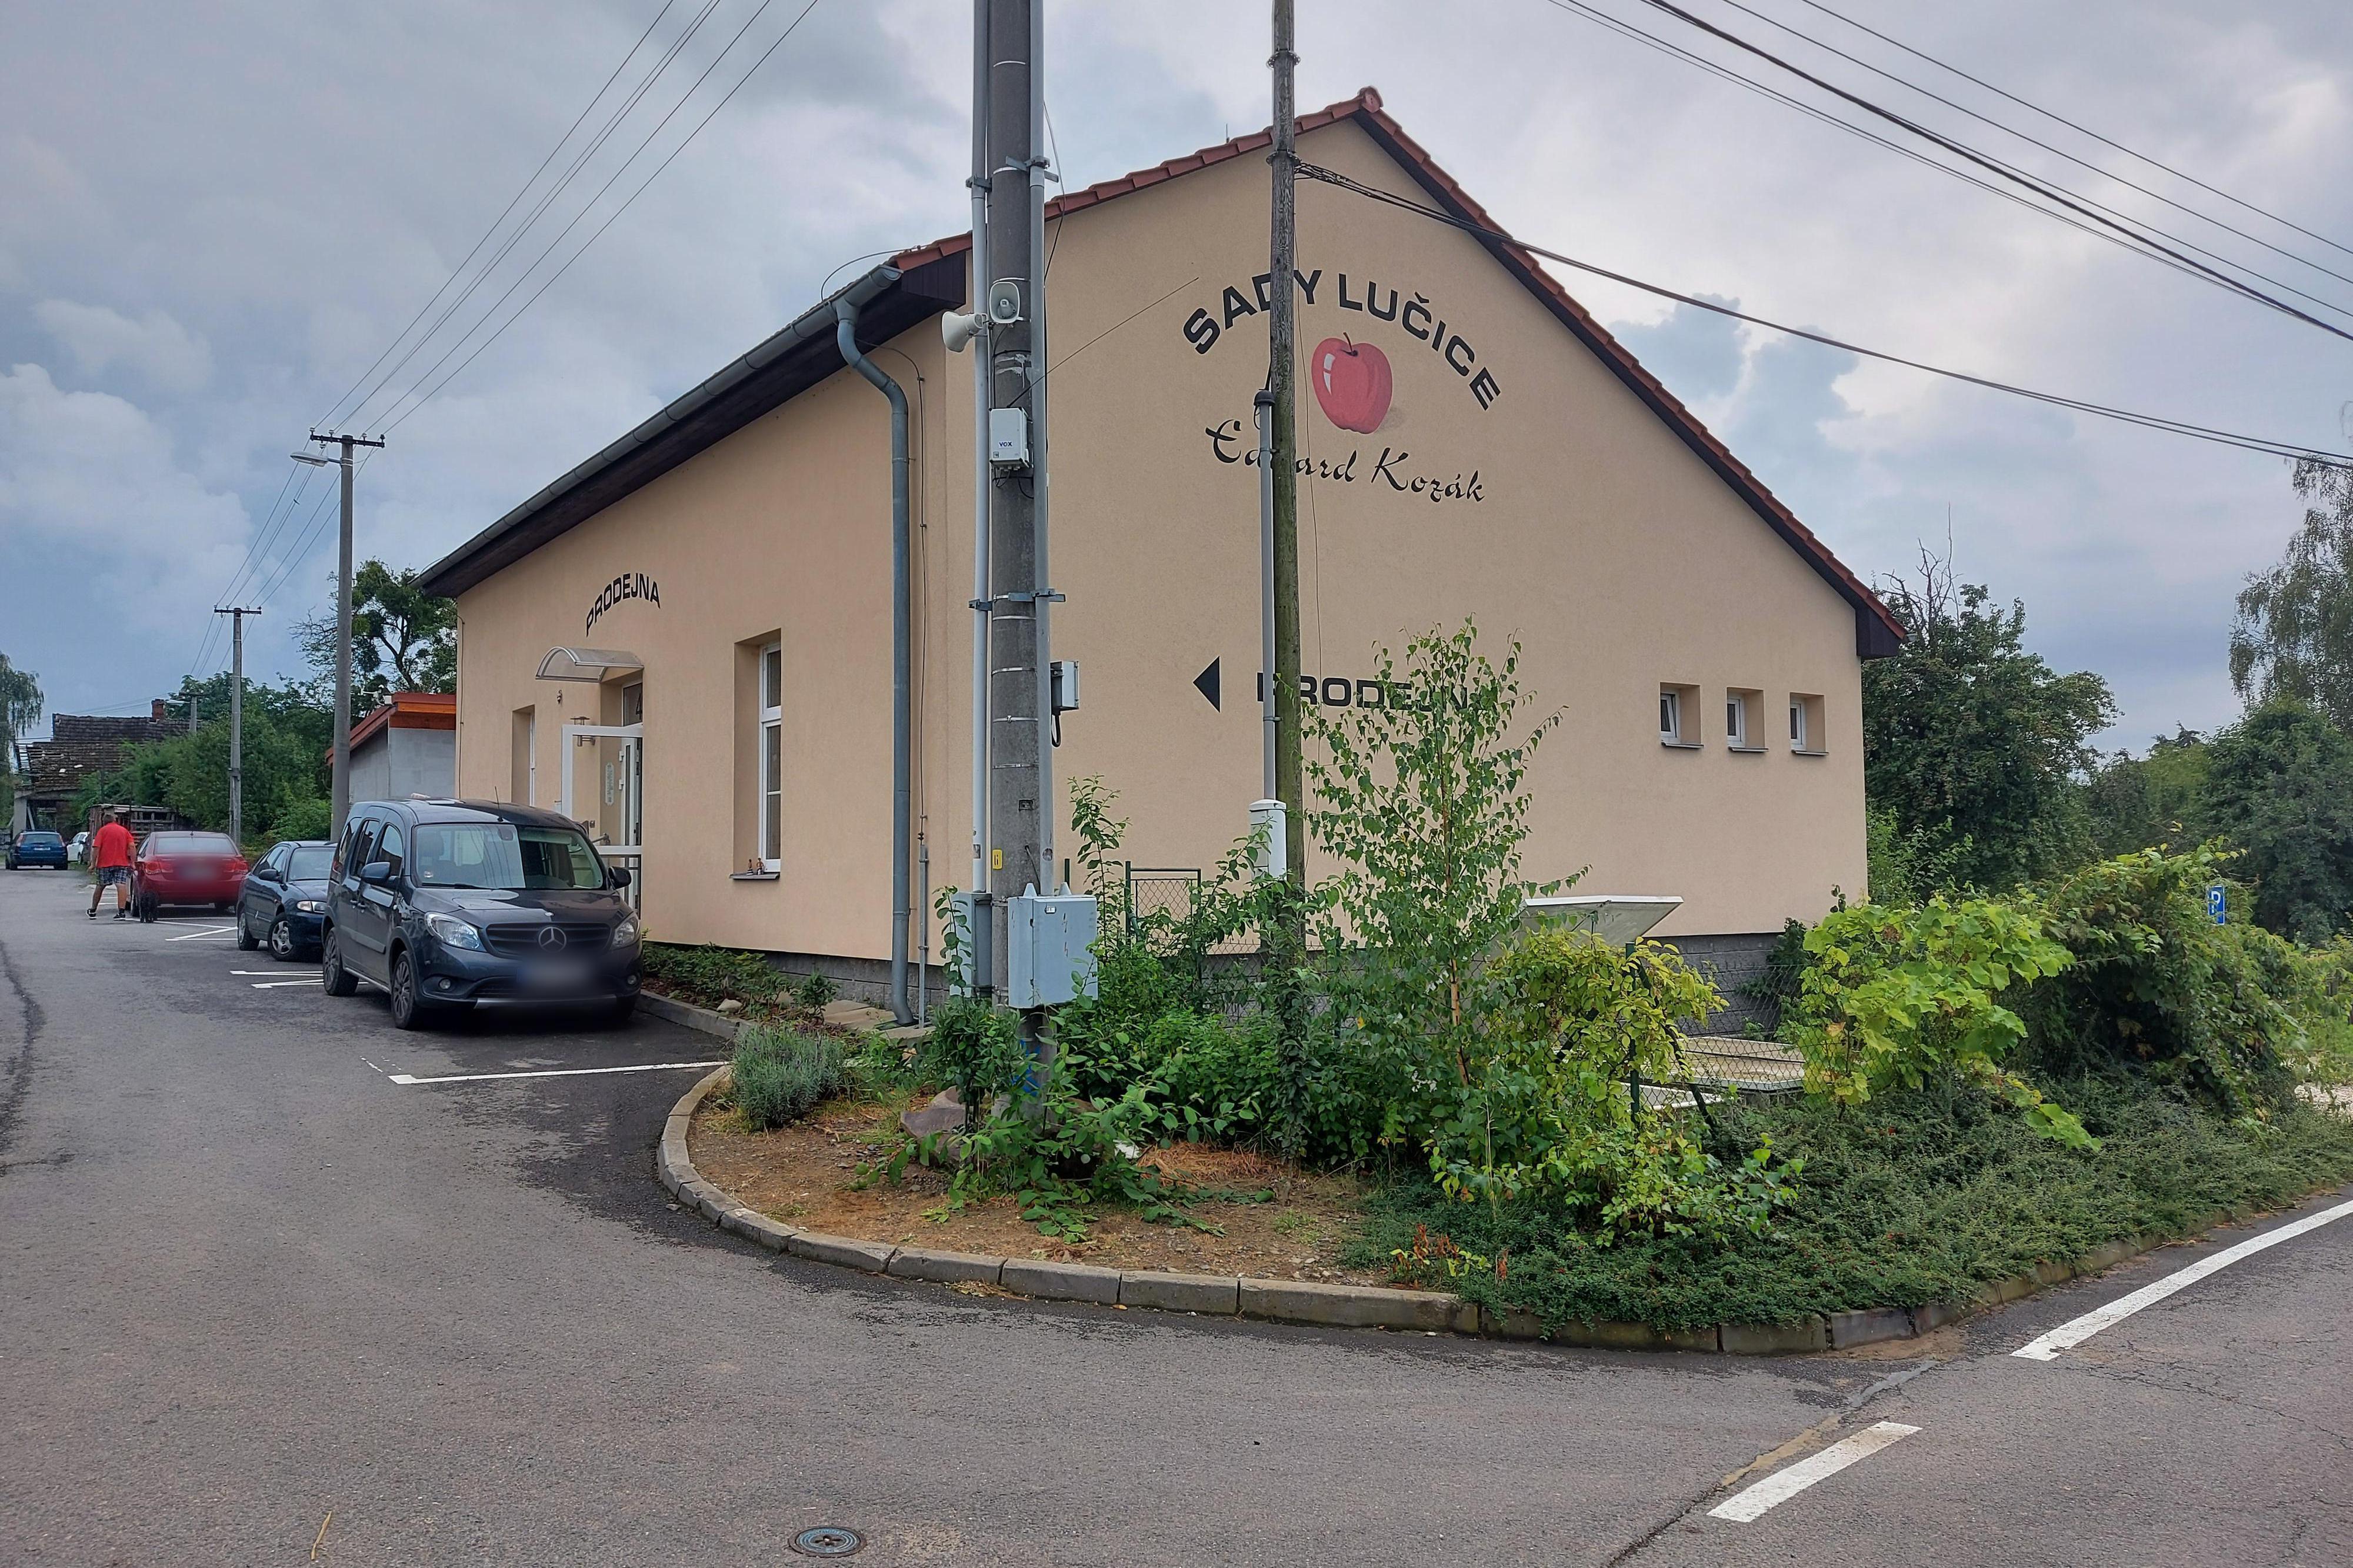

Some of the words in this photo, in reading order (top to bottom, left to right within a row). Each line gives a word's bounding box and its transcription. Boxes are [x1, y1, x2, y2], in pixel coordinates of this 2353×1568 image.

[1338, 273, 1501, 411] LUČICE
[1205, 419, 1357, 482] Eard
[1371, 448, 1485, 502] Kozák
[586, 573, 661, 637] PRODEJNA
[2211, 891, 2221, 913] P
